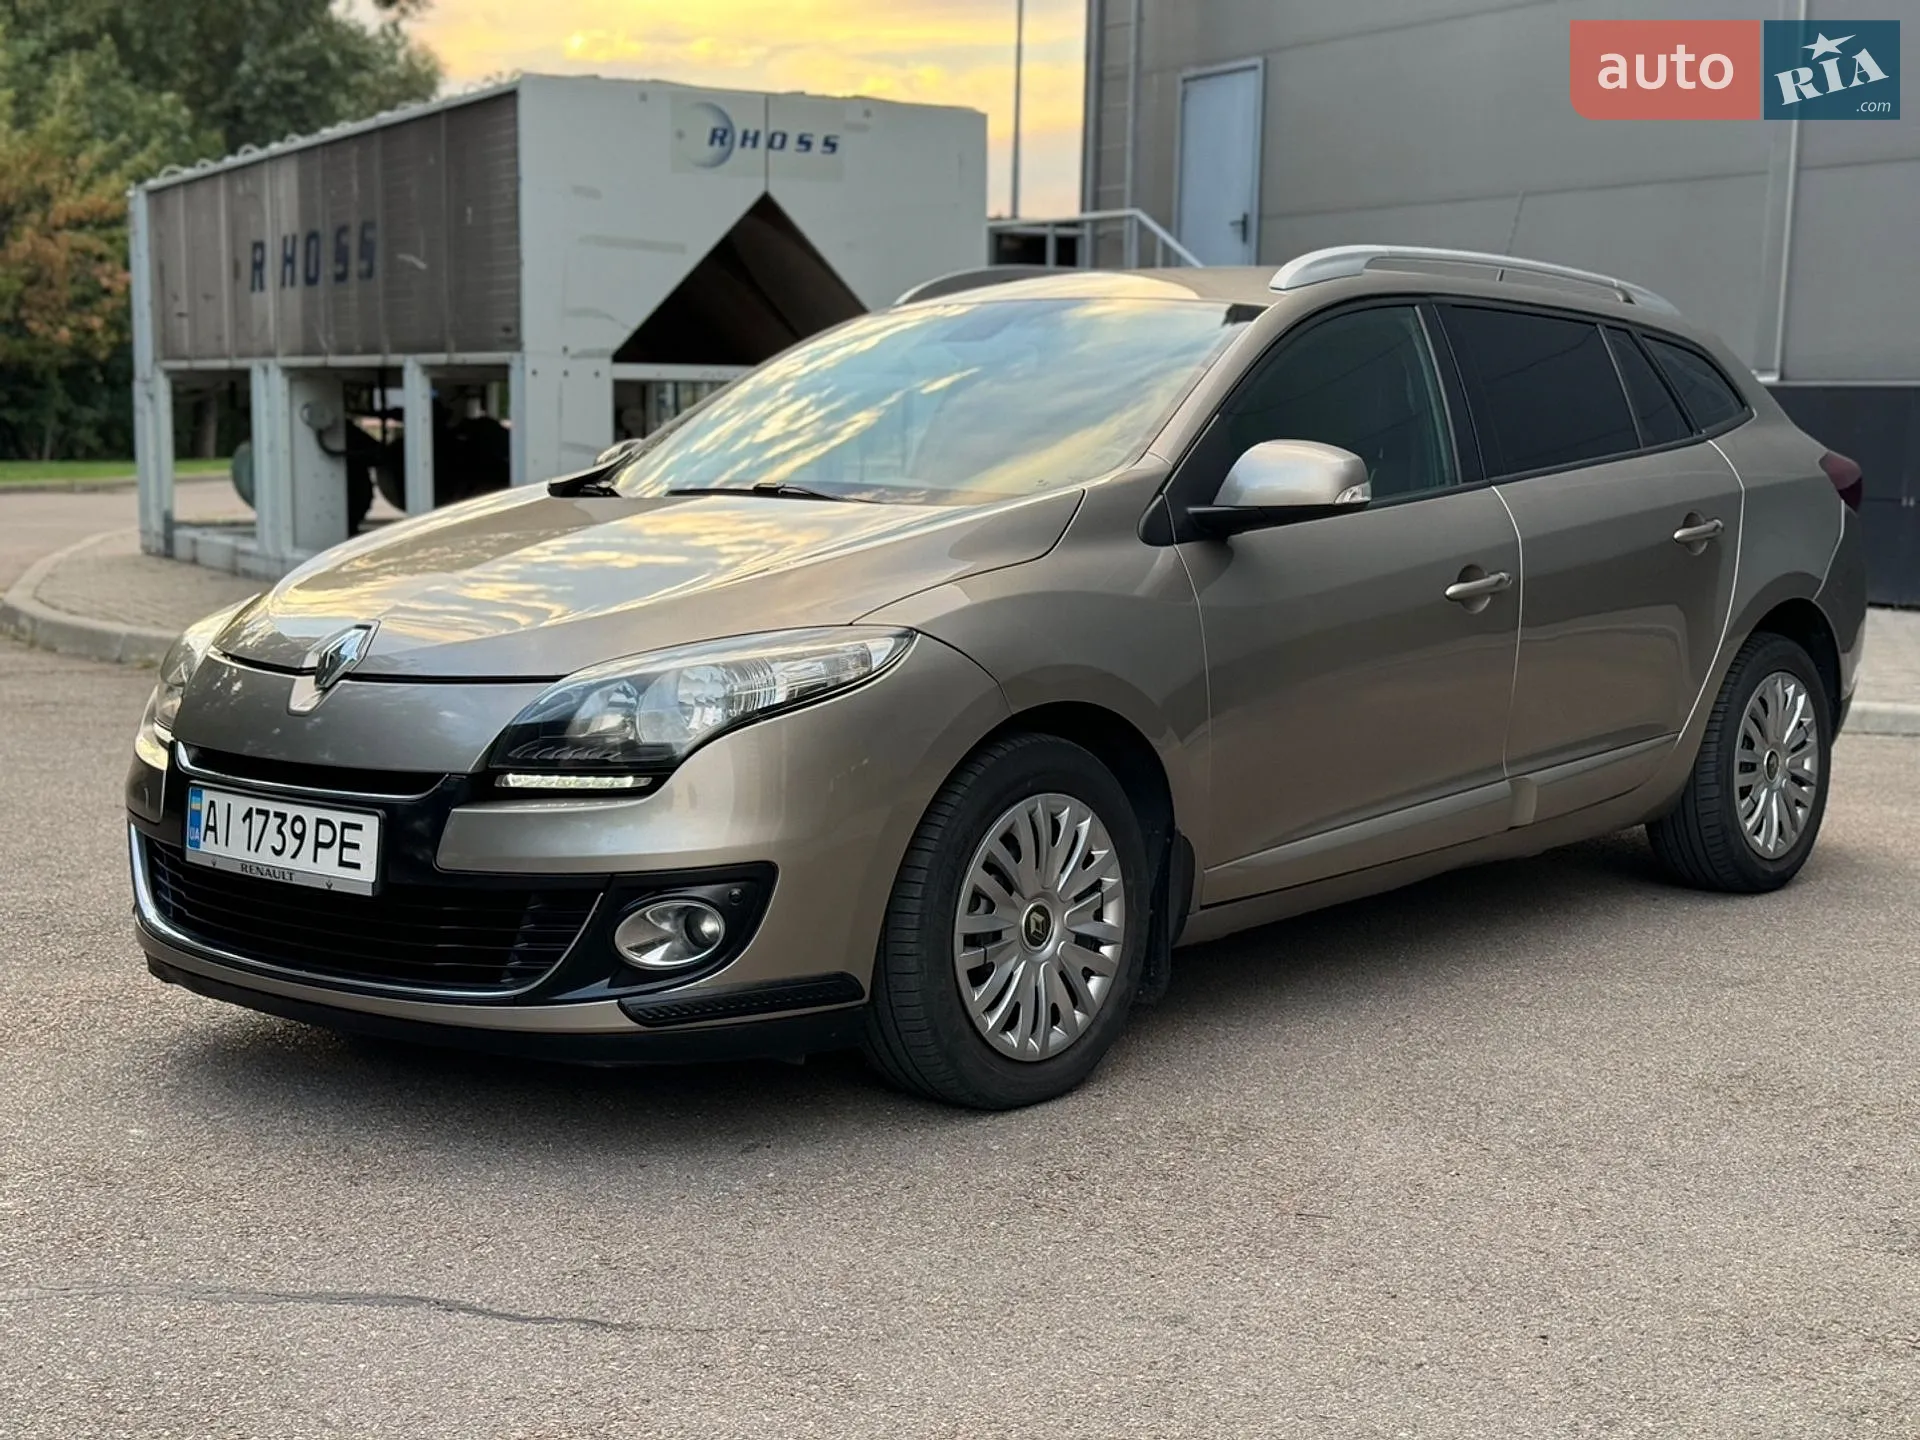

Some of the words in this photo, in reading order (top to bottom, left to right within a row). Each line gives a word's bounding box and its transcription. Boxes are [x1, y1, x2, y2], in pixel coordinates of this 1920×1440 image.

[708, 127, 840, 154] RHOSS
[251, 220, 376, 292] RHOSS
[203, 800, 232, 847] AI
[241, 806, 307, 860] 1739
[312, 817, 363, 870] PE
[240, 863, 295, 882] RENAULT
